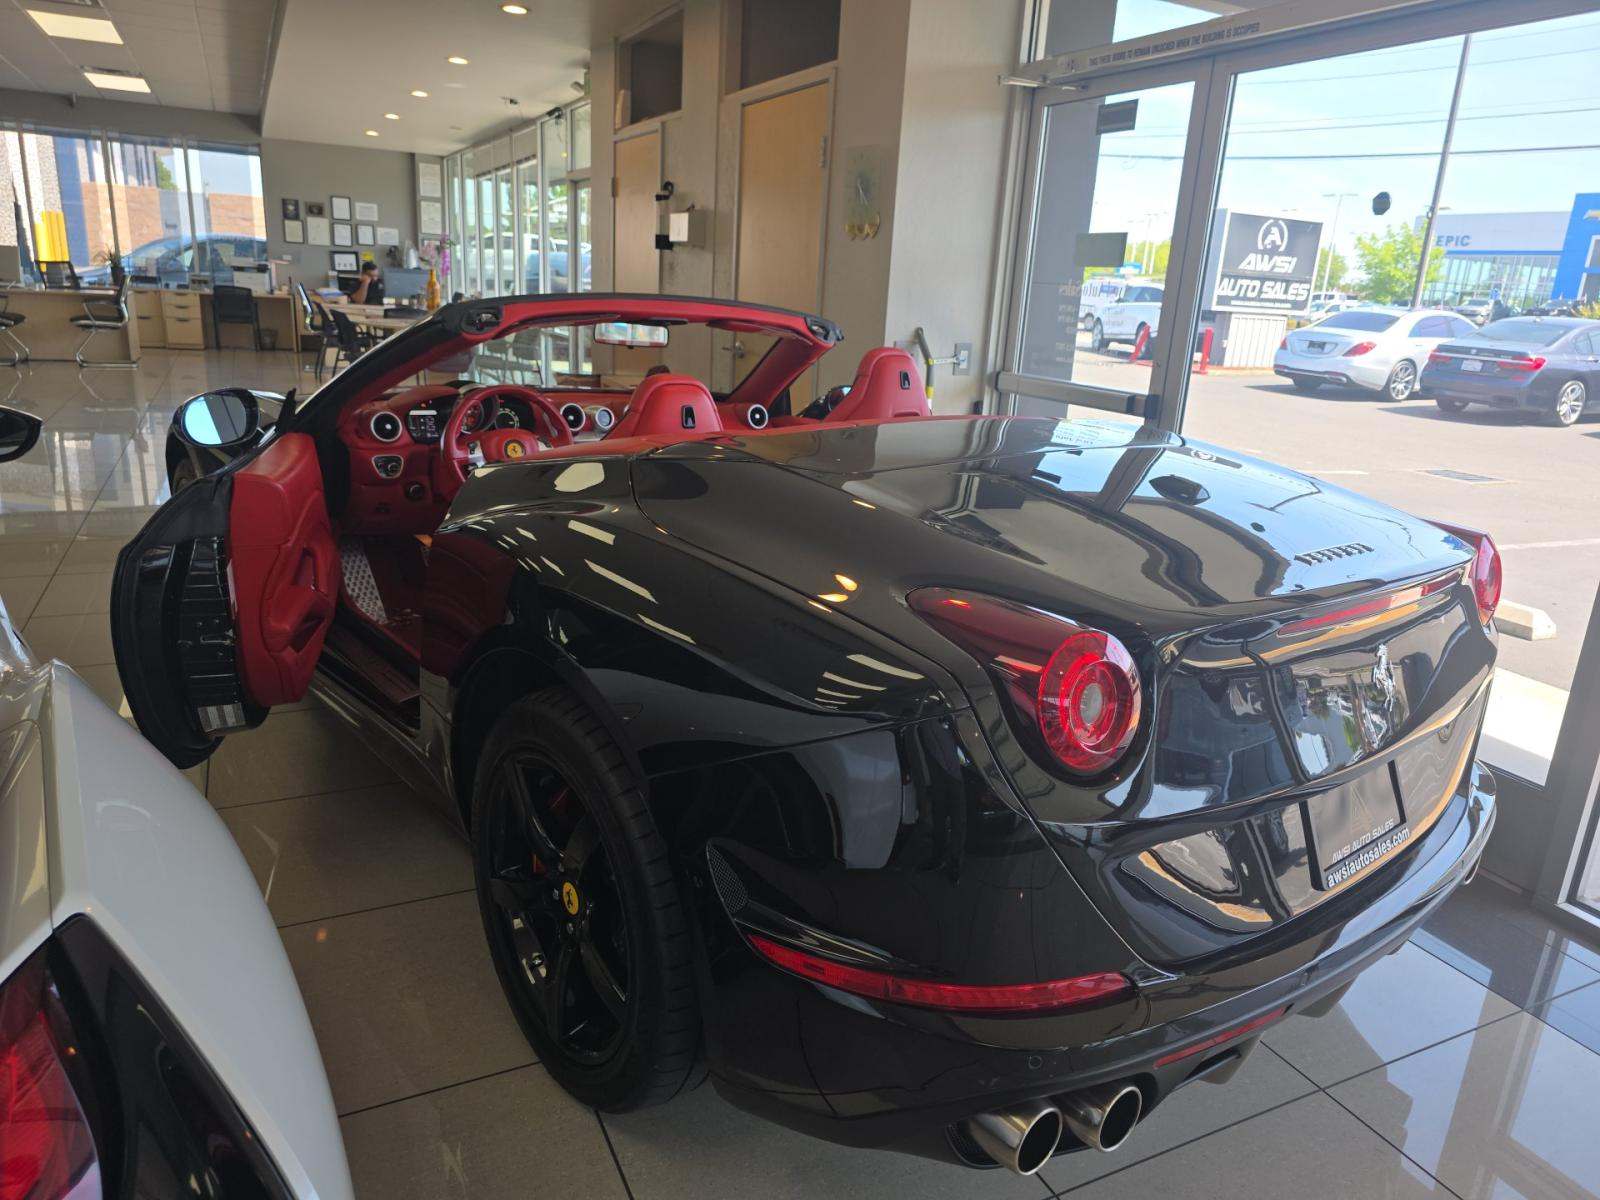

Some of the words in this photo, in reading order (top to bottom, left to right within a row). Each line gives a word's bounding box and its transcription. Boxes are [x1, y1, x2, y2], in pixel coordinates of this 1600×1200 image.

[1435, 235, 1472, 247] EPIC
[1238, 252, 1298, 274] AWSI
[1218, 277, 1260, 298] AUTO
[1260, 280, 1311, 301] SALES
[1332, 845, 1351, 862] AWSI
[1352, 833, 1371, 852] AUTO
[1372, 818, 1394, 839] SALES
[1327, 827, 1410, 887] awsiautosales.com
